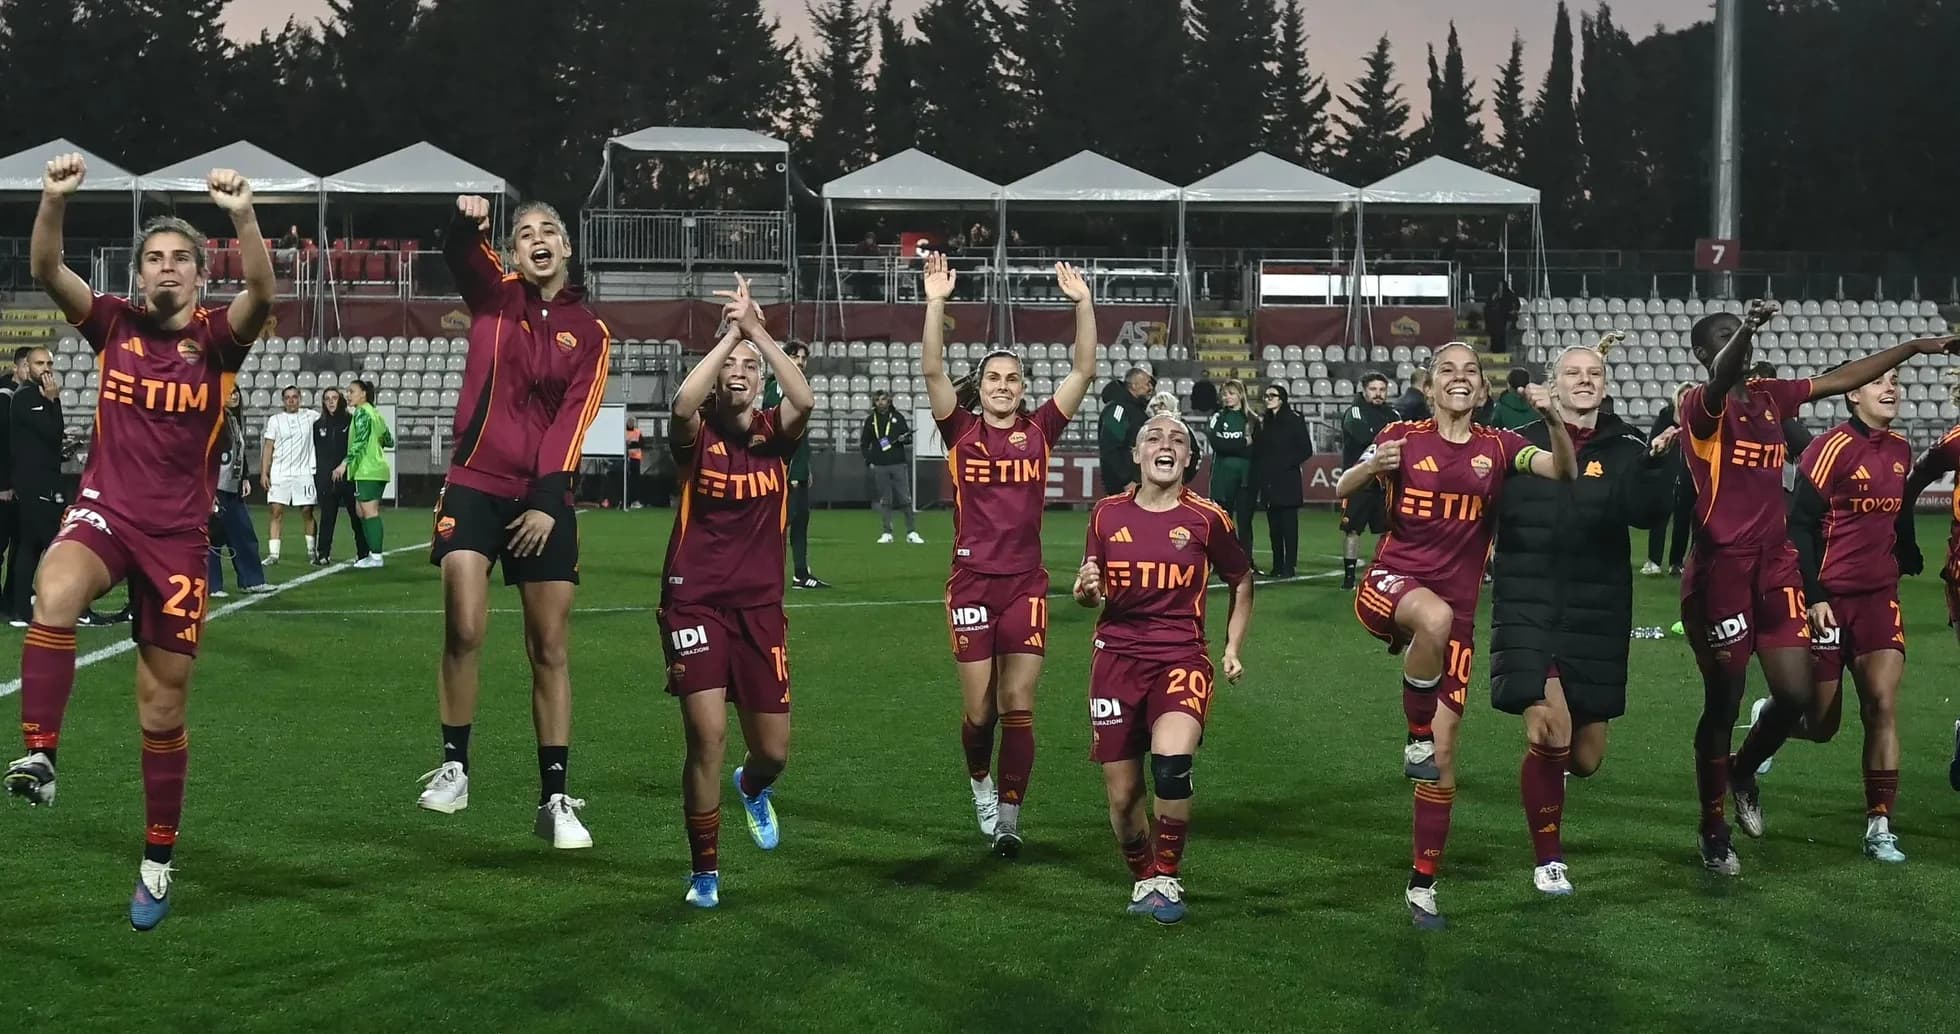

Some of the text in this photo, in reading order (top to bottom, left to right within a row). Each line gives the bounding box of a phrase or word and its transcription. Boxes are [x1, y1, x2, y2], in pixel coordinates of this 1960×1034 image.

[1711, 245, 1725, 265] 7
[141, 378, 208, 413] TIM
[730, 468, 780, 500] TIM
[996, 459, 1040, 483] TIM
[303, 485, 315, 497] 10
[1137, 562, 1195, 589] TIM
[163, 574, 206, 620] 23
[952, 606, 988, 625] HDI
[1028, 597, 1045, 629] 11
[1447, 640, 1472, 684] 10
[1166, 668, 1206, 699] 20
